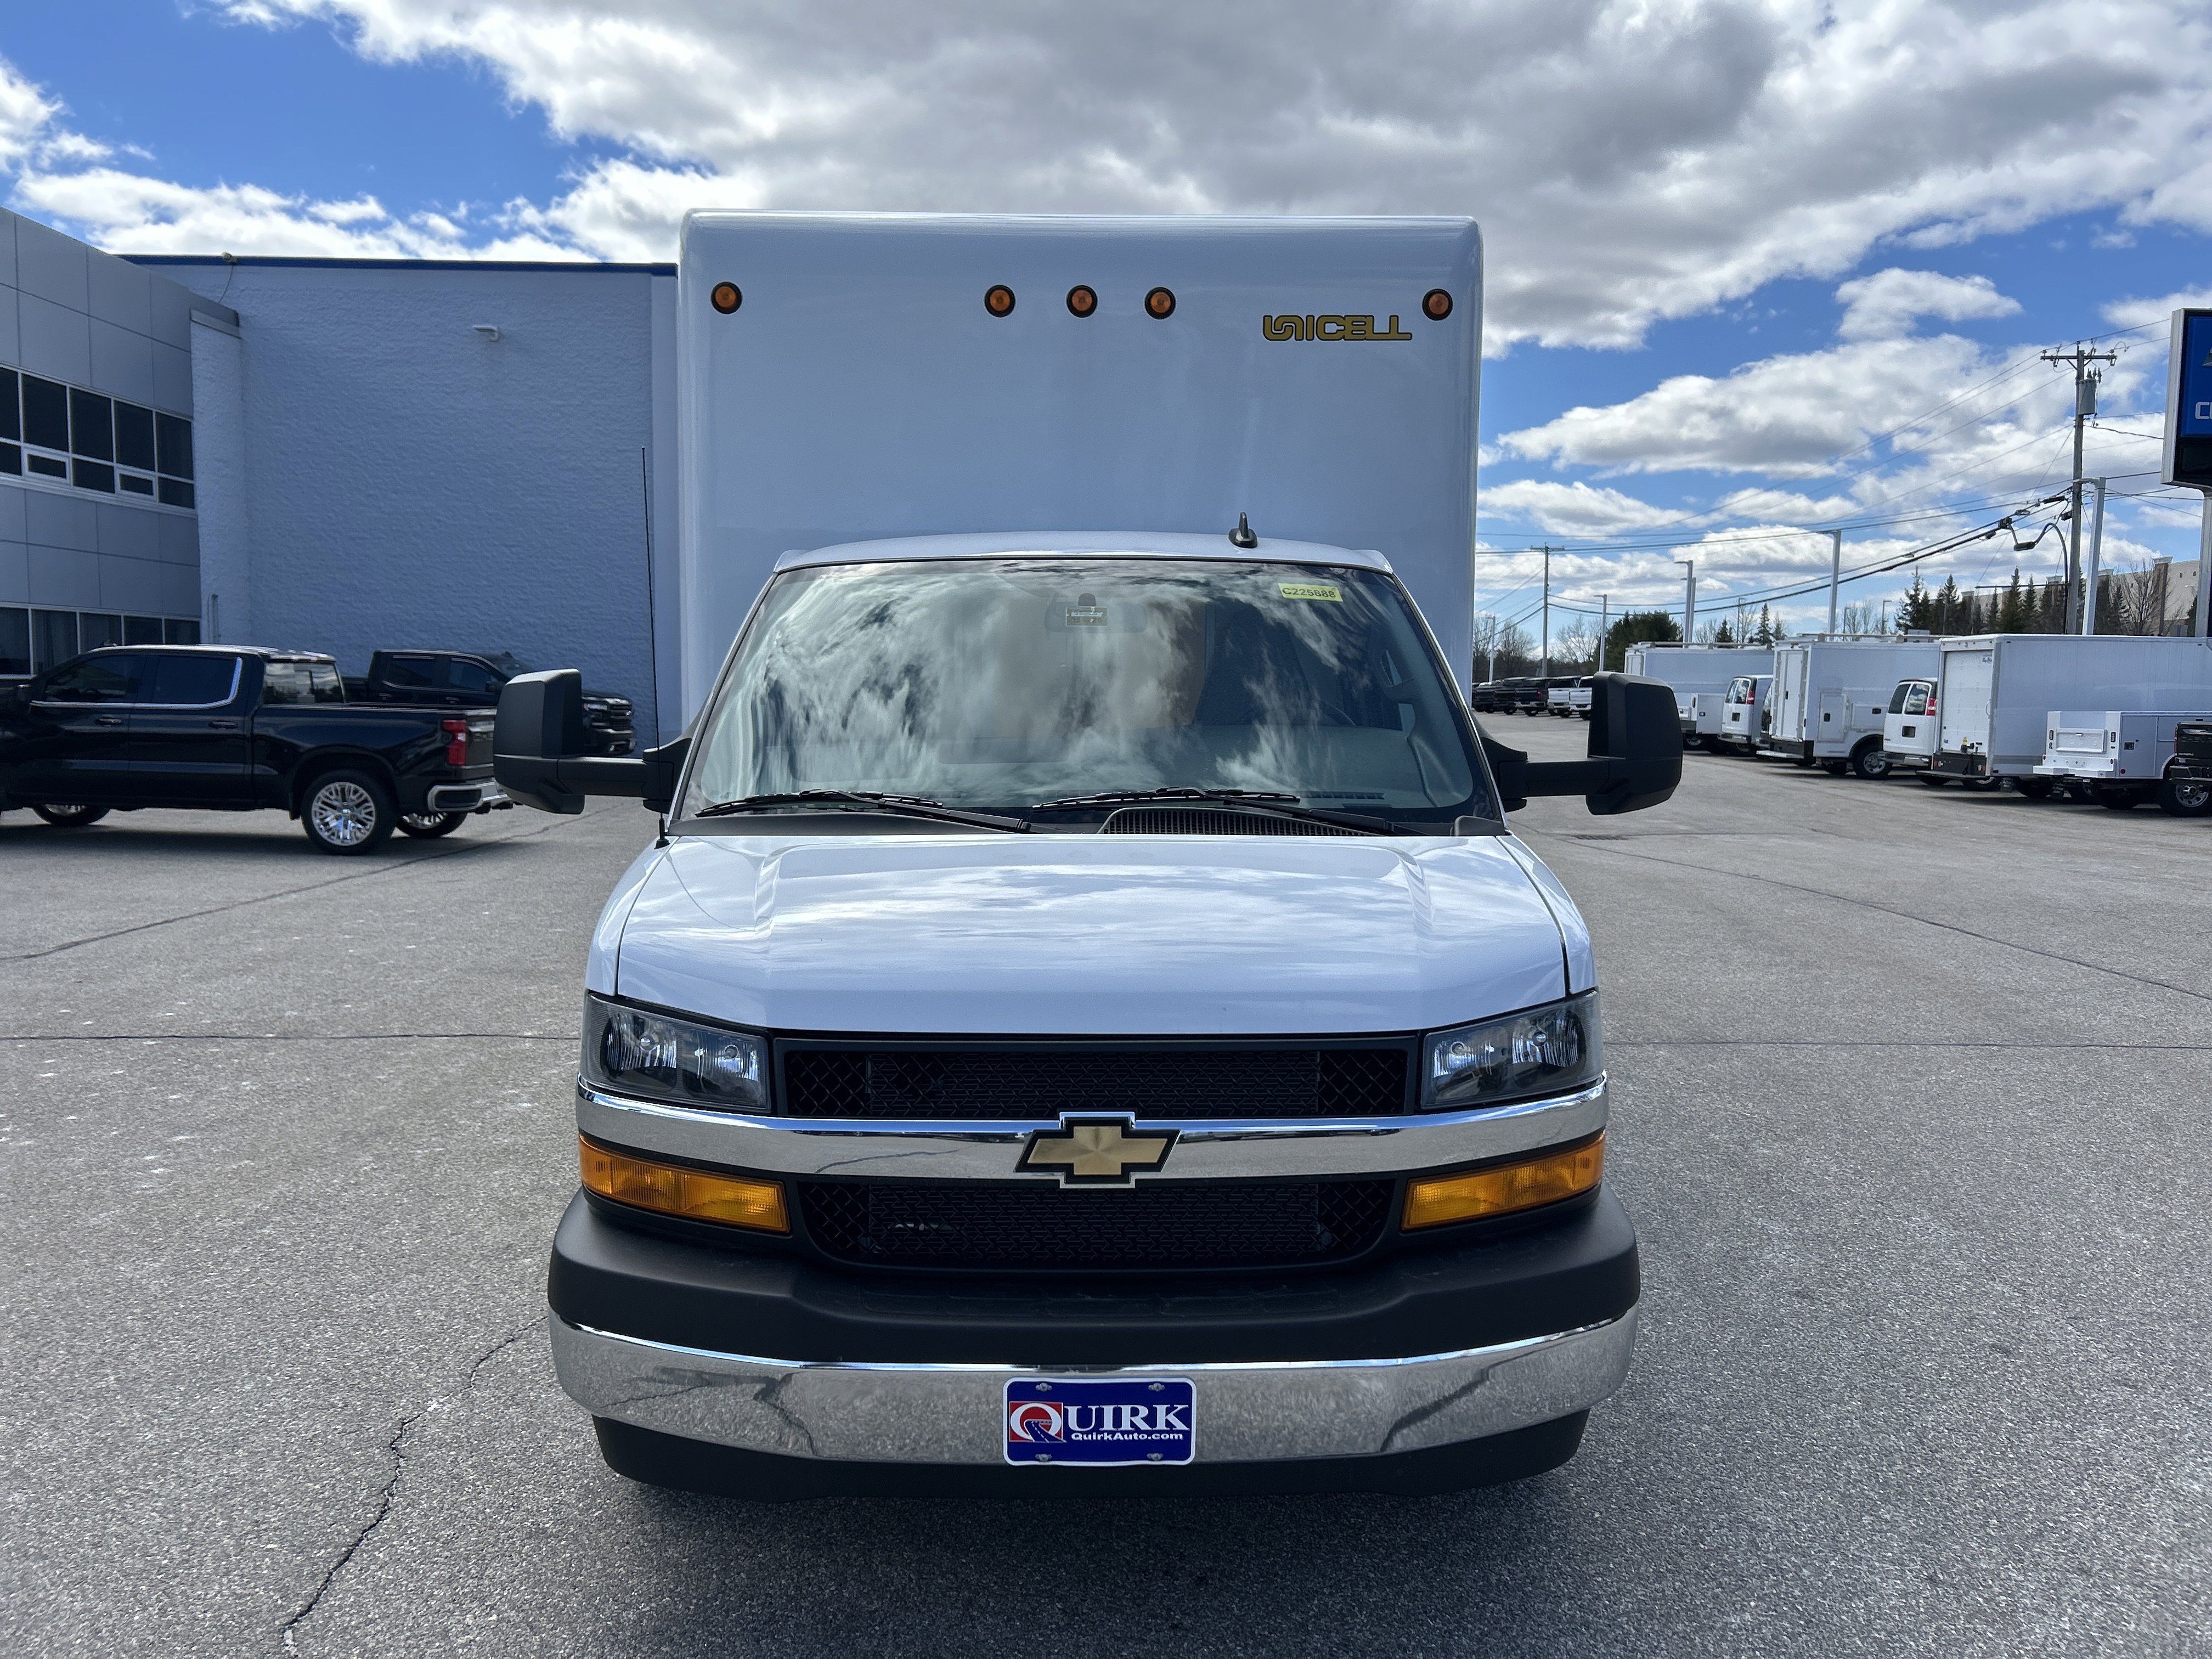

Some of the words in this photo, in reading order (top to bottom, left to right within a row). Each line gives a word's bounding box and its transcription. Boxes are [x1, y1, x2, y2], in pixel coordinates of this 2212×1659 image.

[1263, 315, 1412, 341] UNICELL
[2195, 402, 2212, 419] C
[1282, 588, 1336, 598] C225888
[1010, 1402, 1190, 1443] QUIRK
[1071, 1432, 1183, 1441] QuirkAuto.com
